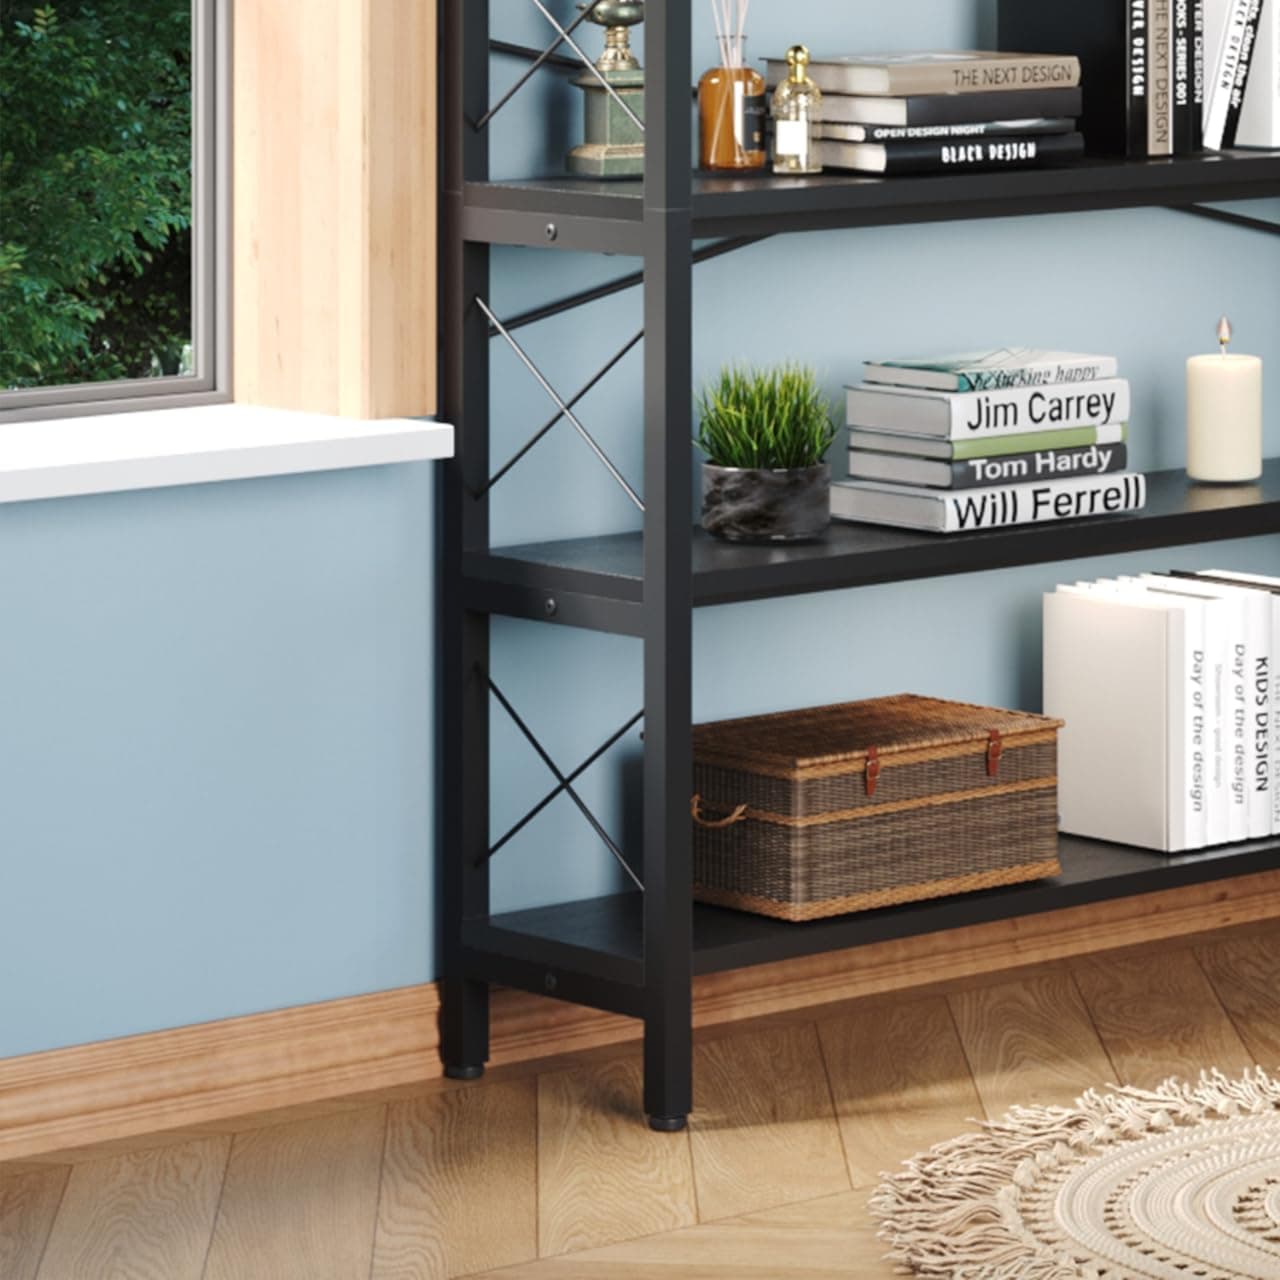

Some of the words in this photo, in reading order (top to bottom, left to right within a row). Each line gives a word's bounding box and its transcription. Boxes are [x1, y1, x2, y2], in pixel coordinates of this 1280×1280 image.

[1132, 37, 1145, 97] DESIGN
[1155, 28, 1168, 71] NEXT
[1176, 37, 1187, 81] SERIES
[1220, 35, 1242, 90] DESIGN
[953, 68, 978, 87] THE
[982, 66, 1018, 85] NEXT
[1022, 64, 1072, 83] DESIGN
[1194, 36, 1203, 103] DESIGN
[1155, 78, 1168, 143] DESIGN
[1176, 82, 1187, 106] 001
[873, 125, 905, 139] OPEN
[907, 125, 949, 137] DESIGN
[950, 123, 987, 136] NIGHT
[941, 146, 983, 163] BLACK
[988, 142, 1036, 161] DESIGN
[1055, 365, 1099, 382] happy
[967, 397, 1018, 430] Jim
[1028, 391, 1116, 425] Carrey
[968, 457, 1028, 481] Tom
[1034, 445, 1112, 473] Hardy
[953, 490, 1018, 529] Will
[1031, 475, 1140, 520] Ferrell
[1190, 650, 1204, 685] Day
[1232, 644, 1246, 678] Day
[1234, 684, 1245, 704] of
[1255, 656, 1269, 706] KIDS
[1192, 691, 1203, 711] of
[1192, 715, 1203, 745] the
[1234, 708, 1245, 738] the
[1255, 712, 1269, 792] DESIGN
[1190, 751, 1203, 813] design
[1231, 744, 1245, 804] design
